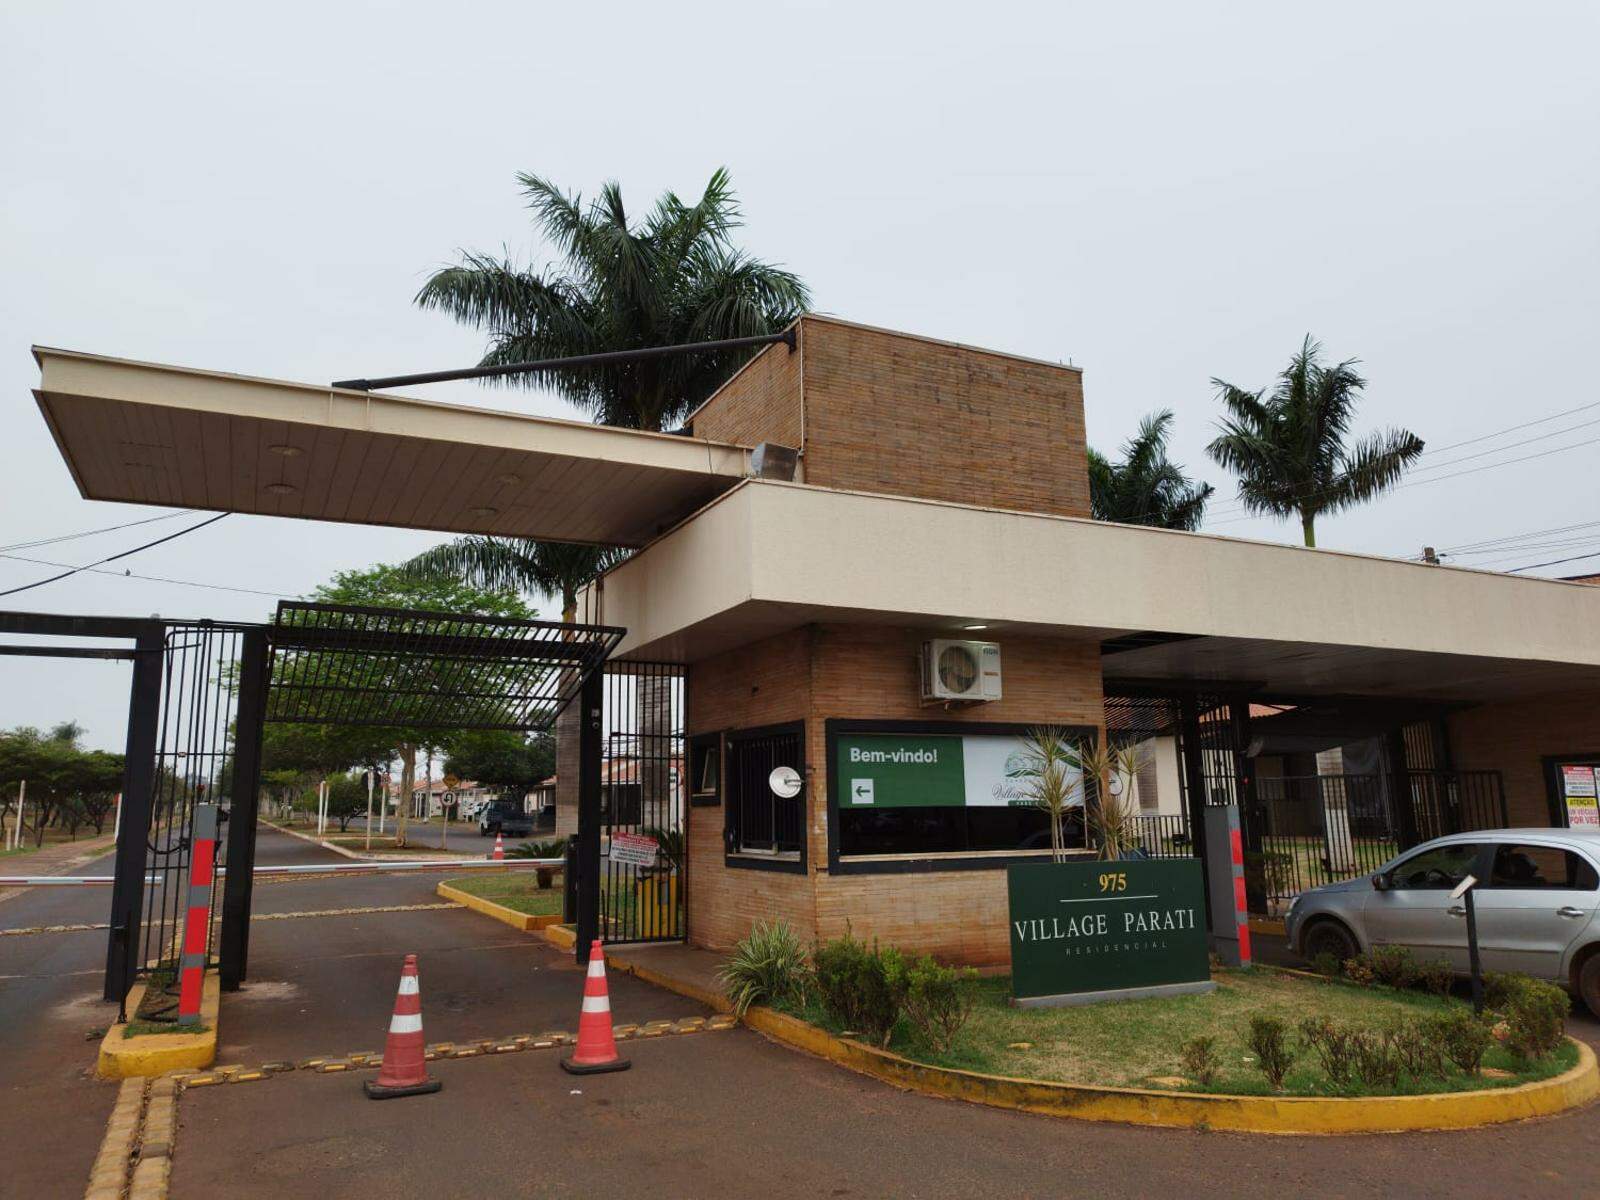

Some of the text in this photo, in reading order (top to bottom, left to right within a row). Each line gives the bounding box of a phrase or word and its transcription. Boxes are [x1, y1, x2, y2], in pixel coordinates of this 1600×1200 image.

[850, 747, 938, 763] Bem-vindo!
[1569, 816, 1583, 824] POR
[1099, 873, 1128, 892] 975
[1014, 909, 1195, 942] VILLAGE PARATI
[1066, 941, 1167, 956] RESIDENCIAL
